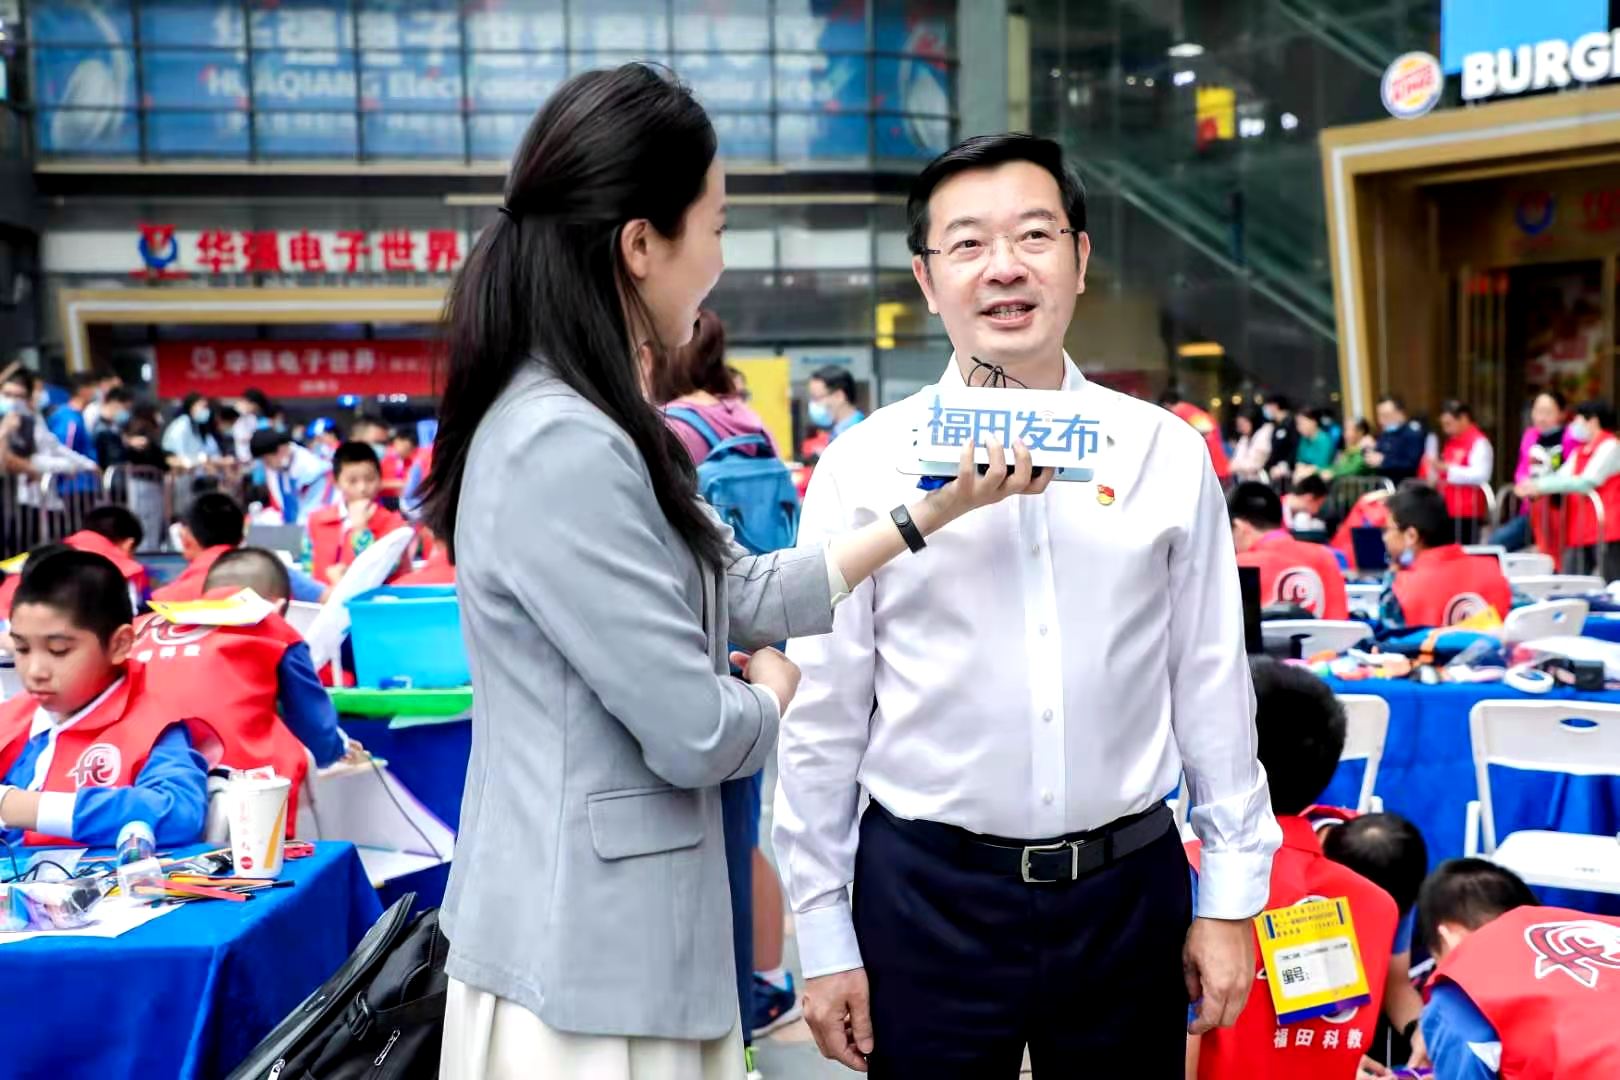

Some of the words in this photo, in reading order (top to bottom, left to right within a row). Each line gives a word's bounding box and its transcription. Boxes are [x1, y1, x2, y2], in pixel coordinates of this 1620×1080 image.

[1461, 27, 1620, 100] BURG
[197, 228, 462, 274] 华强电子世界
[927, 394, 1100, 460] 福田发布
[1273, 1028, 1363, 1049] 福田科教
